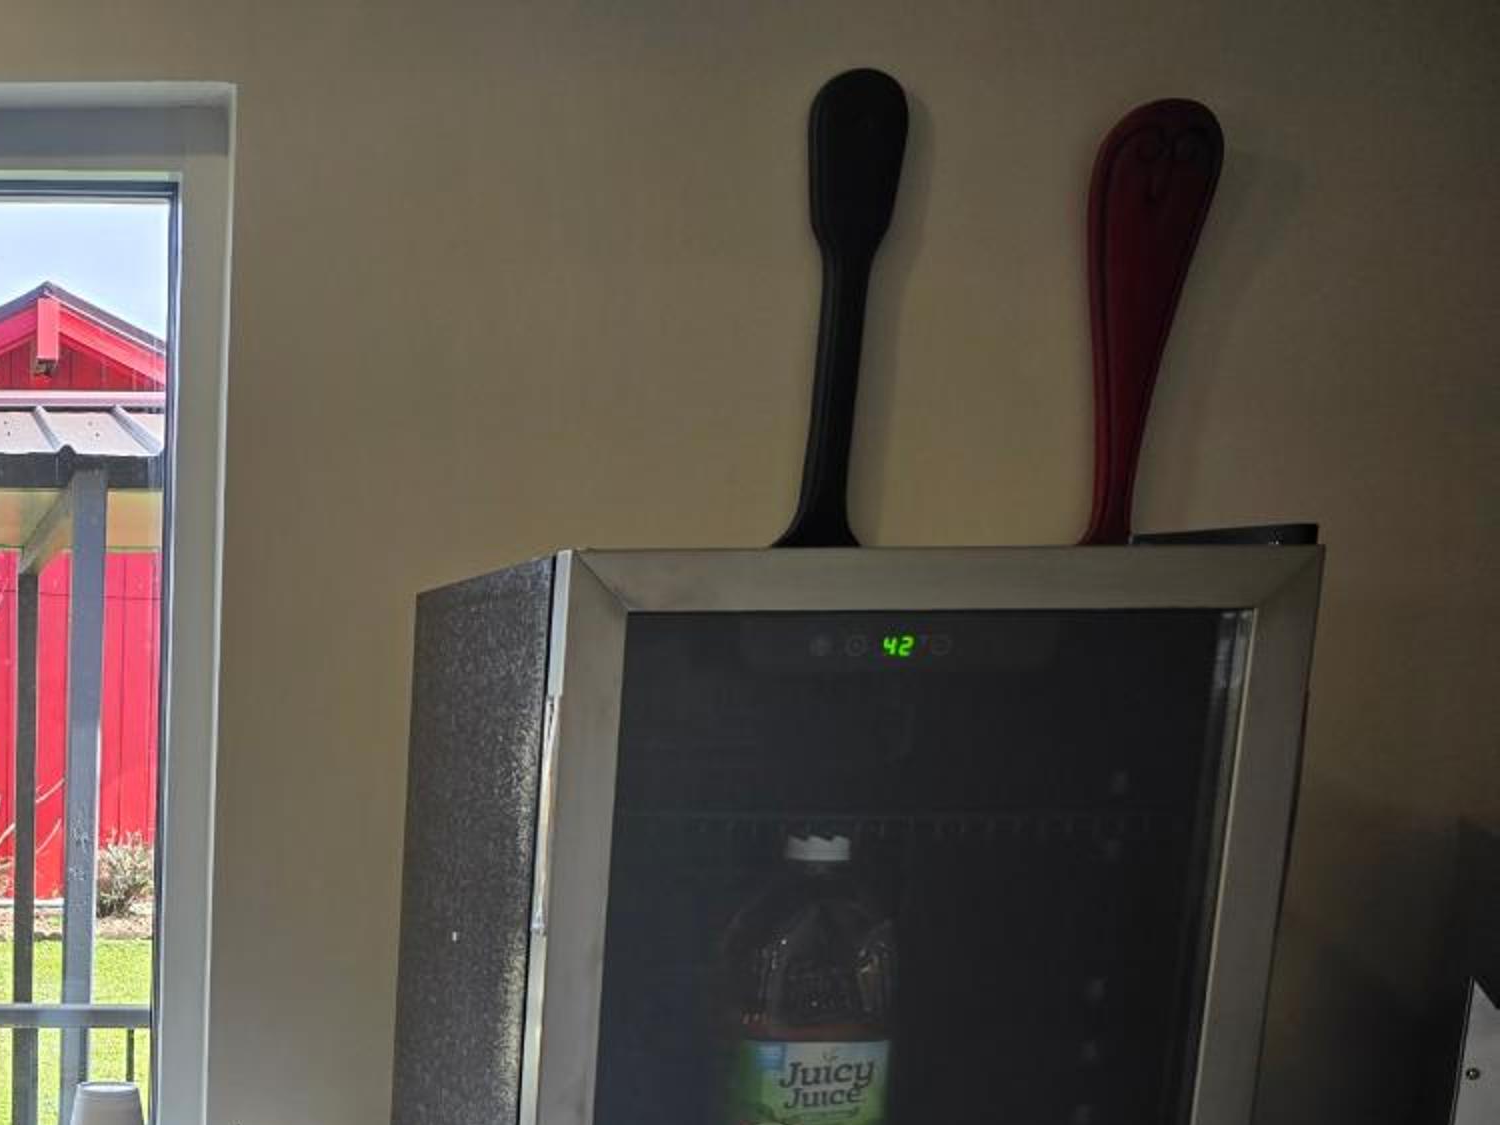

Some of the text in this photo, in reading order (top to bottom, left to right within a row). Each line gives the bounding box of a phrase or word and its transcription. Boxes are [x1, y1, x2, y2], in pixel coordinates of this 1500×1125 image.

[883, 636, 915, 656] 42
[779, 1061, 875, 1088] Juicy
[783, 1086, 863, 1109] Juice
